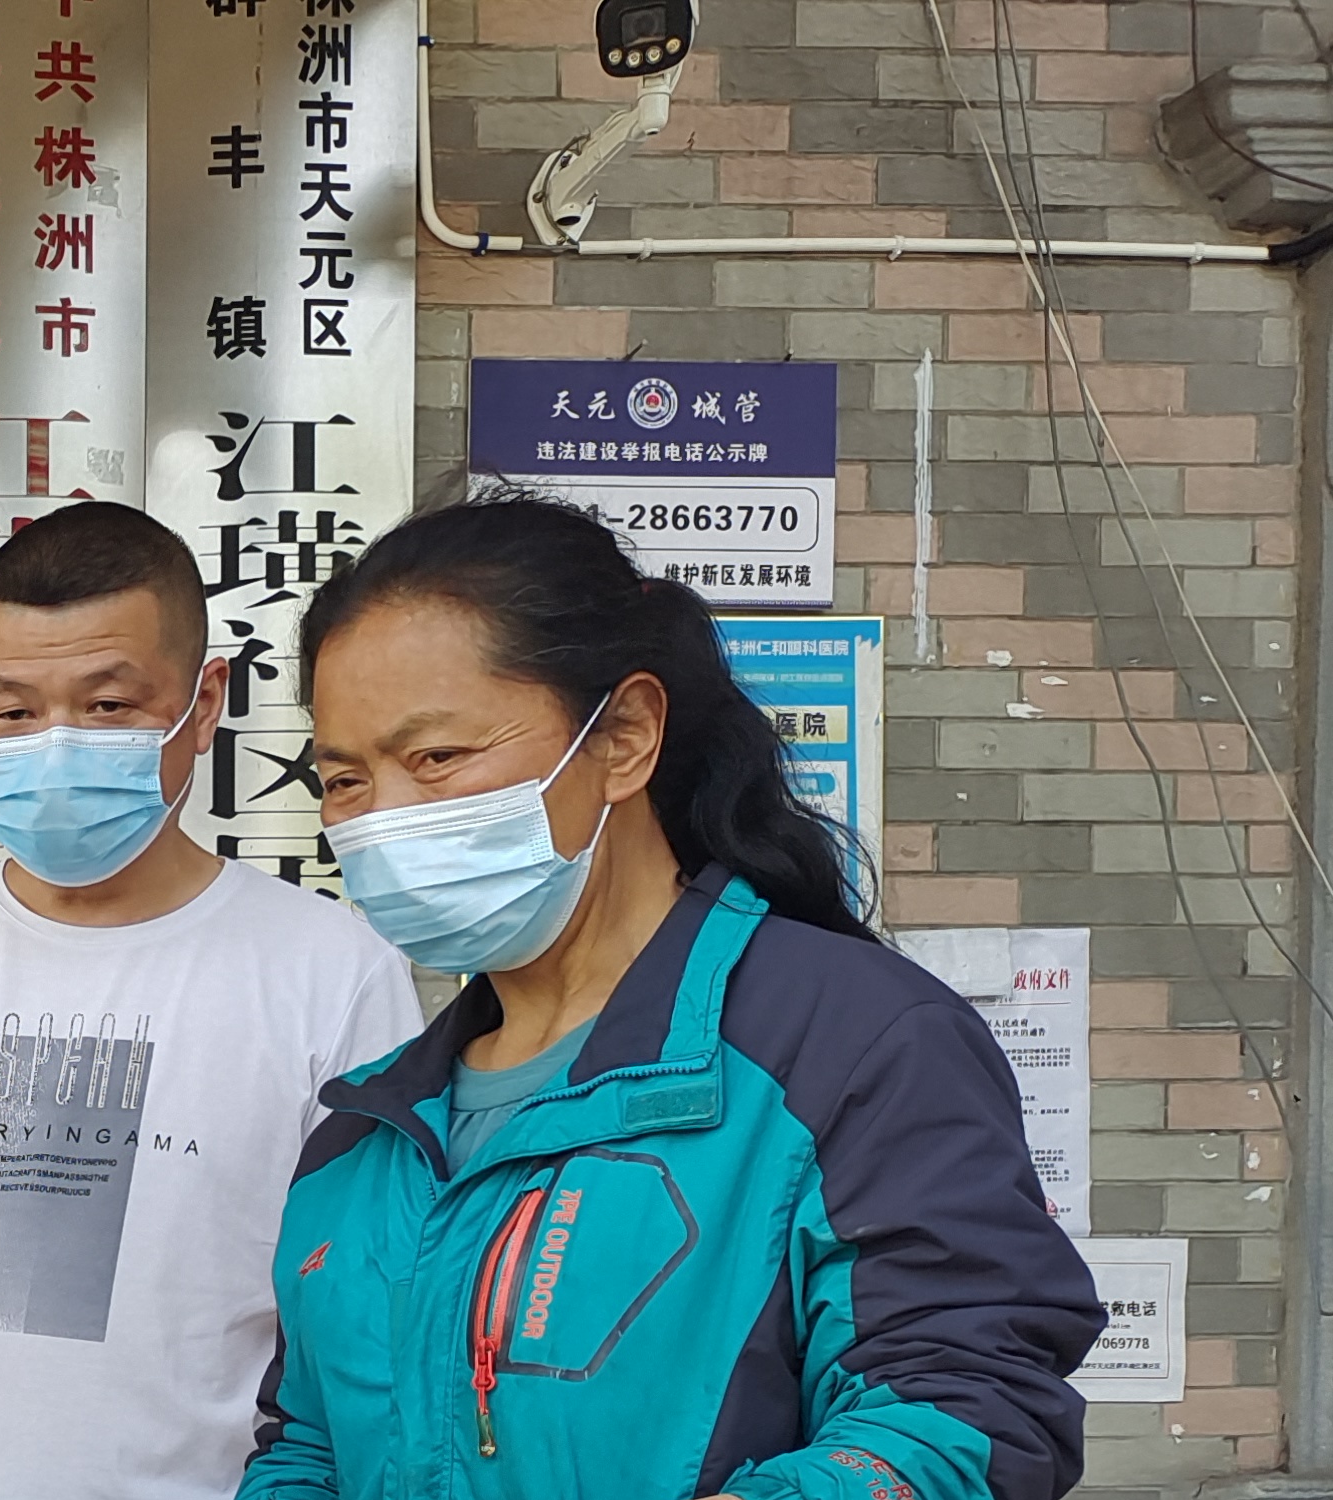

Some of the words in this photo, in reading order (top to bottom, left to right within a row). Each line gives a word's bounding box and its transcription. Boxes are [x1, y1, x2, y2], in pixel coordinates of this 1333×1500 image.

[33, 0, 97, 358] 共株洲市
[298, 0, 355, 357] 洲市天元区
[536, 441, 769, 463] 违法建设举报电话公示牌
[549, 391, 616, 421] 天元
[521, 1228, 570, 1341] OUTDOOR
